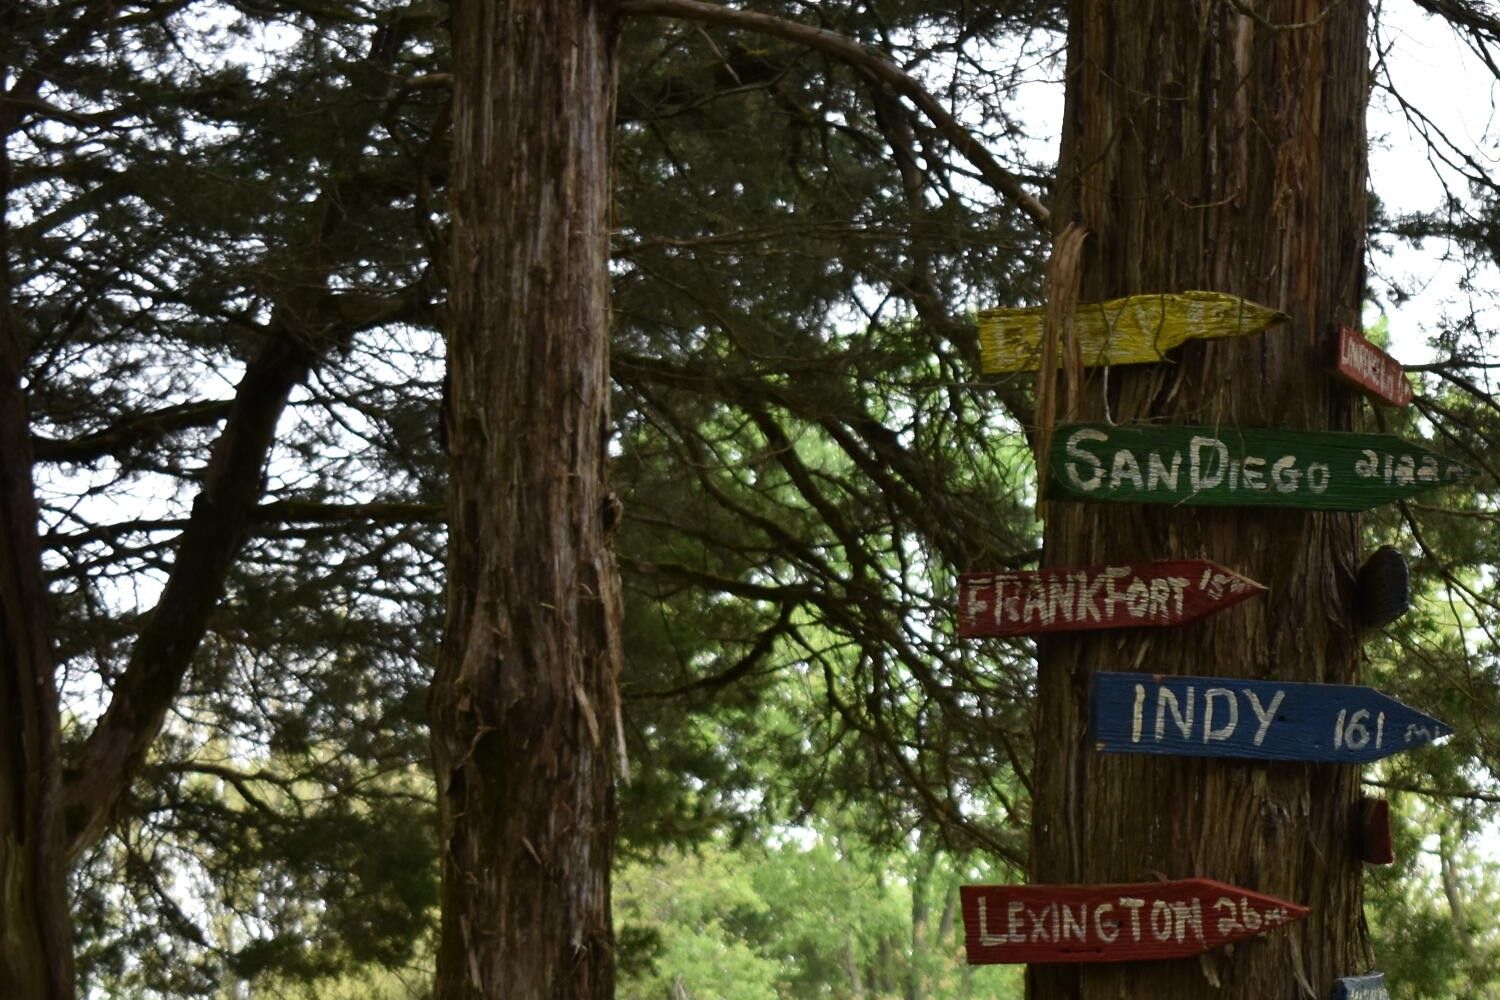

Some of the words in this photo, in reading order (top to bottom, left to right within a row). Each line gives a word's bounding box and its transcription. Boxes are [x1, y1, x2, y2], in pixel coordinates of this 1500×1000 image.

[967, 565, 1190, 626] FRANKFORT
[1132, 684, 1285, 746] INDY
[1334, 708, 1386, 749] 161
[978, 896, 1206, 947] LEXINGTON
[1213, 897, 1263, 936] 26
